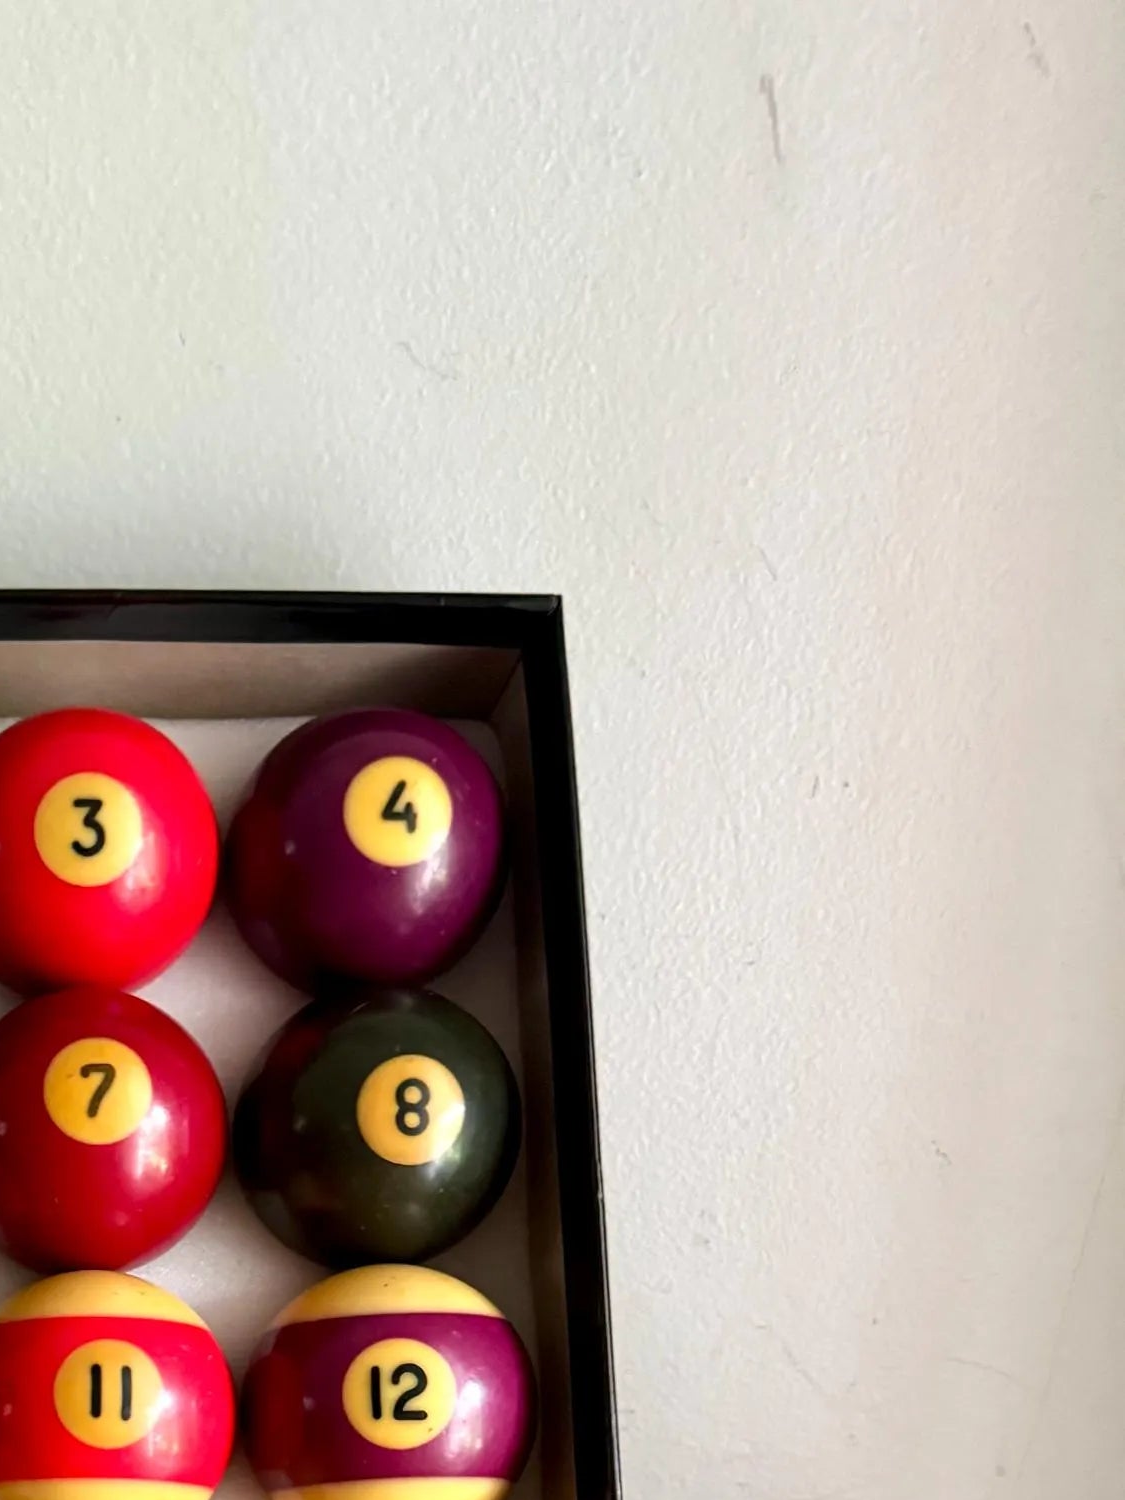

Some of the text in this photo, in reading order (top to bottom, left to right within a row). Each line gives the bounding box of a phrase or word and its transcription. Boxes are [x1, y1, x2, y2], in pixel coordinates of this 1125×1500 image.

[71, 798, 105, 857] 3
[381, 780, 417, 833] 4
[80, 1063, 115, 1118] 7
[395, 1078, 430, 1136] 8
[89, 1363, 131, 1421] 11
[369, 1363, 427, 1420] 12
